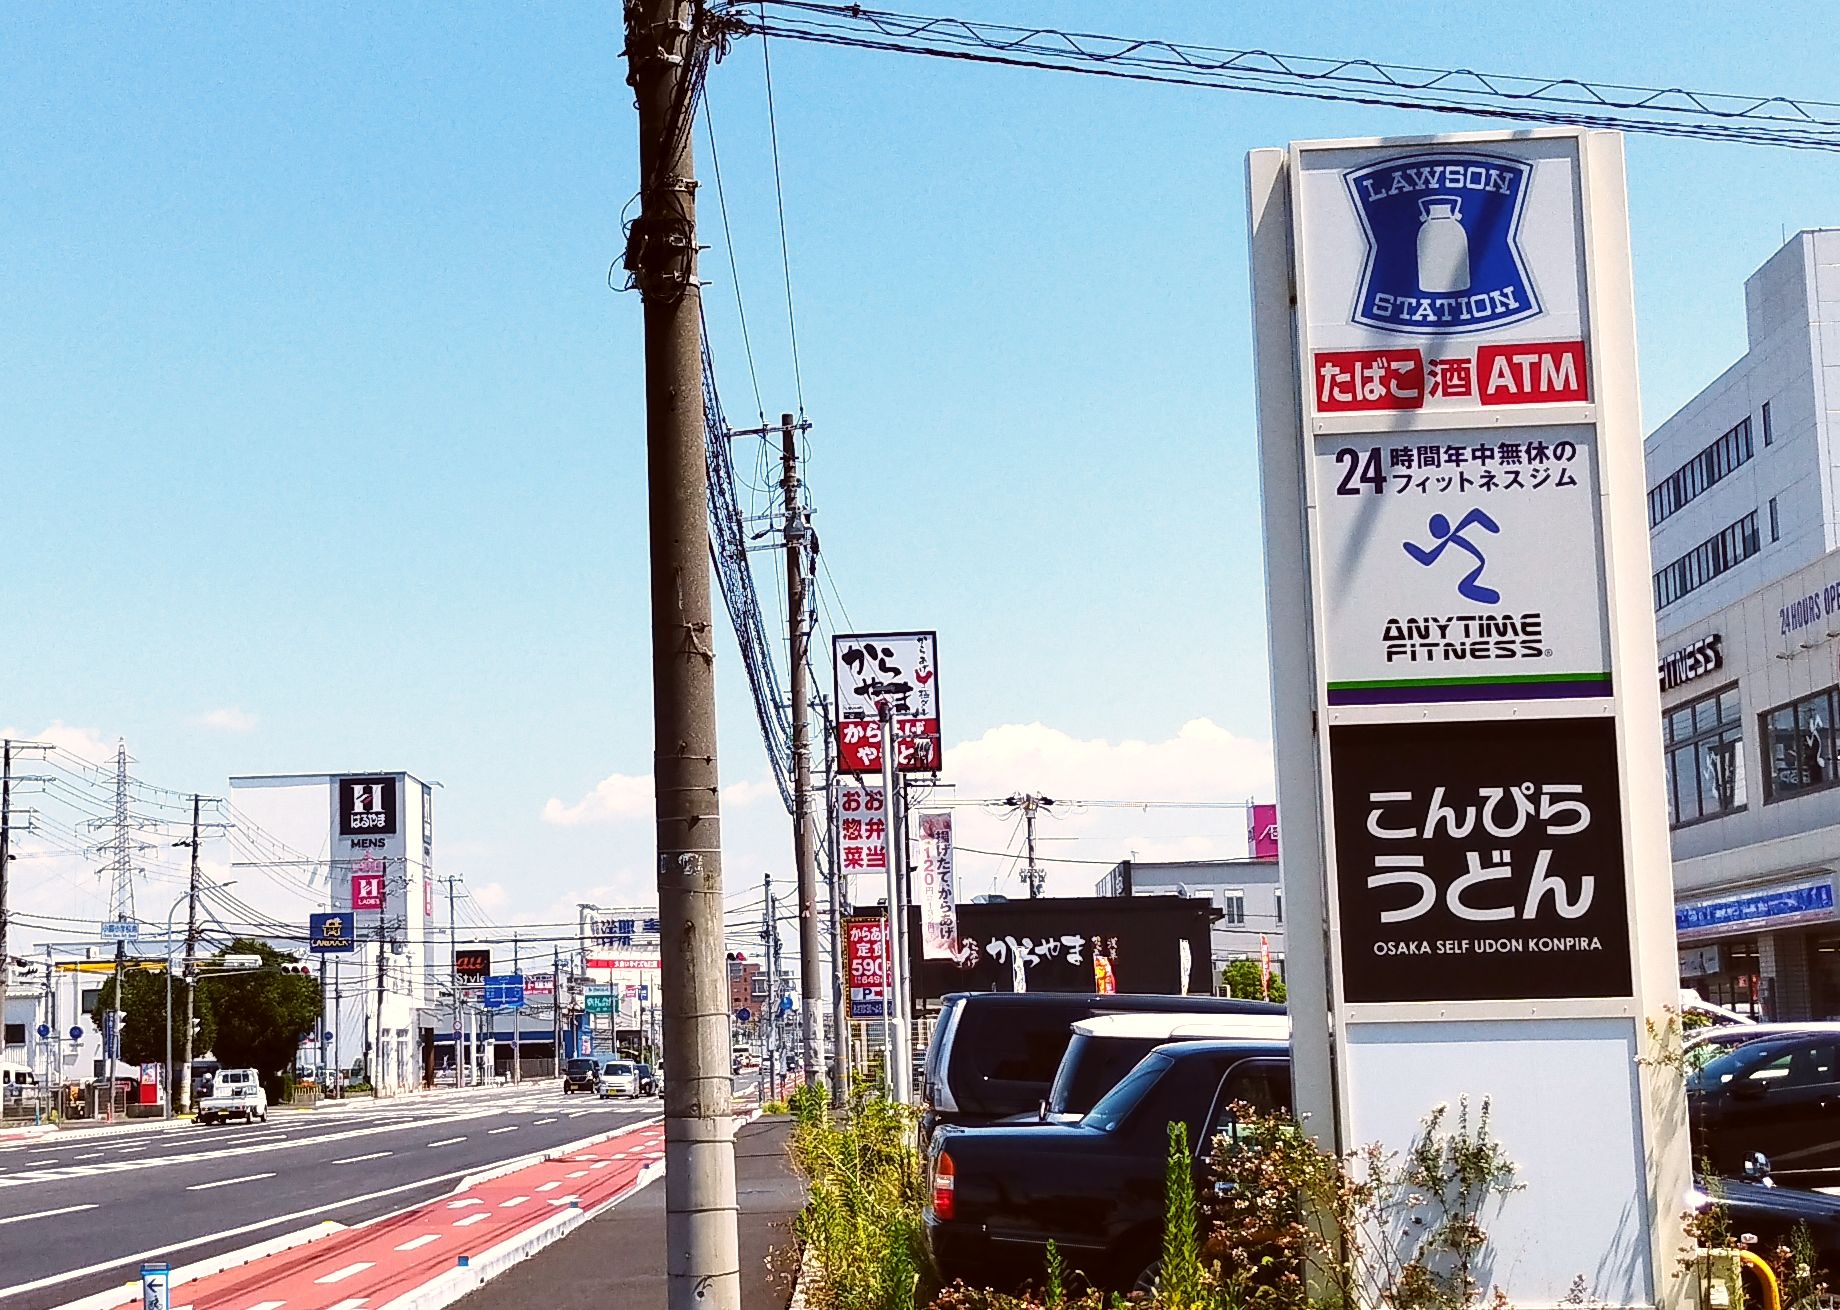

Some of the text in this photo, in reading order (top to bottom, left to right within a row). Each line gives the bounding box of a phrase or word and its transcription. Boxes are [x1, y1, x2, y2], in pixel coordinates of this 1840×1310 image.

[1363, 165, 1514, 202] LAWSON
[1372, 286, 1520, 322] STATION
[1320, 352, 1579, 403] たばこ 酒 ATM
[1392, 467, 1579, 494] フィットネスジム
[1382, 613, 1542, 641] ANYTIME
[350, 813, 386, 828] はるやま
[1366, 781, 1591, 839] こんぴら
[350, 838, 386, 849] MENS
[842, 790, 864, 869] お惣菜
[864, 790, 886, 868] お弁当
[1366, 849, 1595, 923] うどん
[456, 956, 485, 970] au
[1373, 936, 1602, 956] OSAKA SELF UDON KONPIRA
